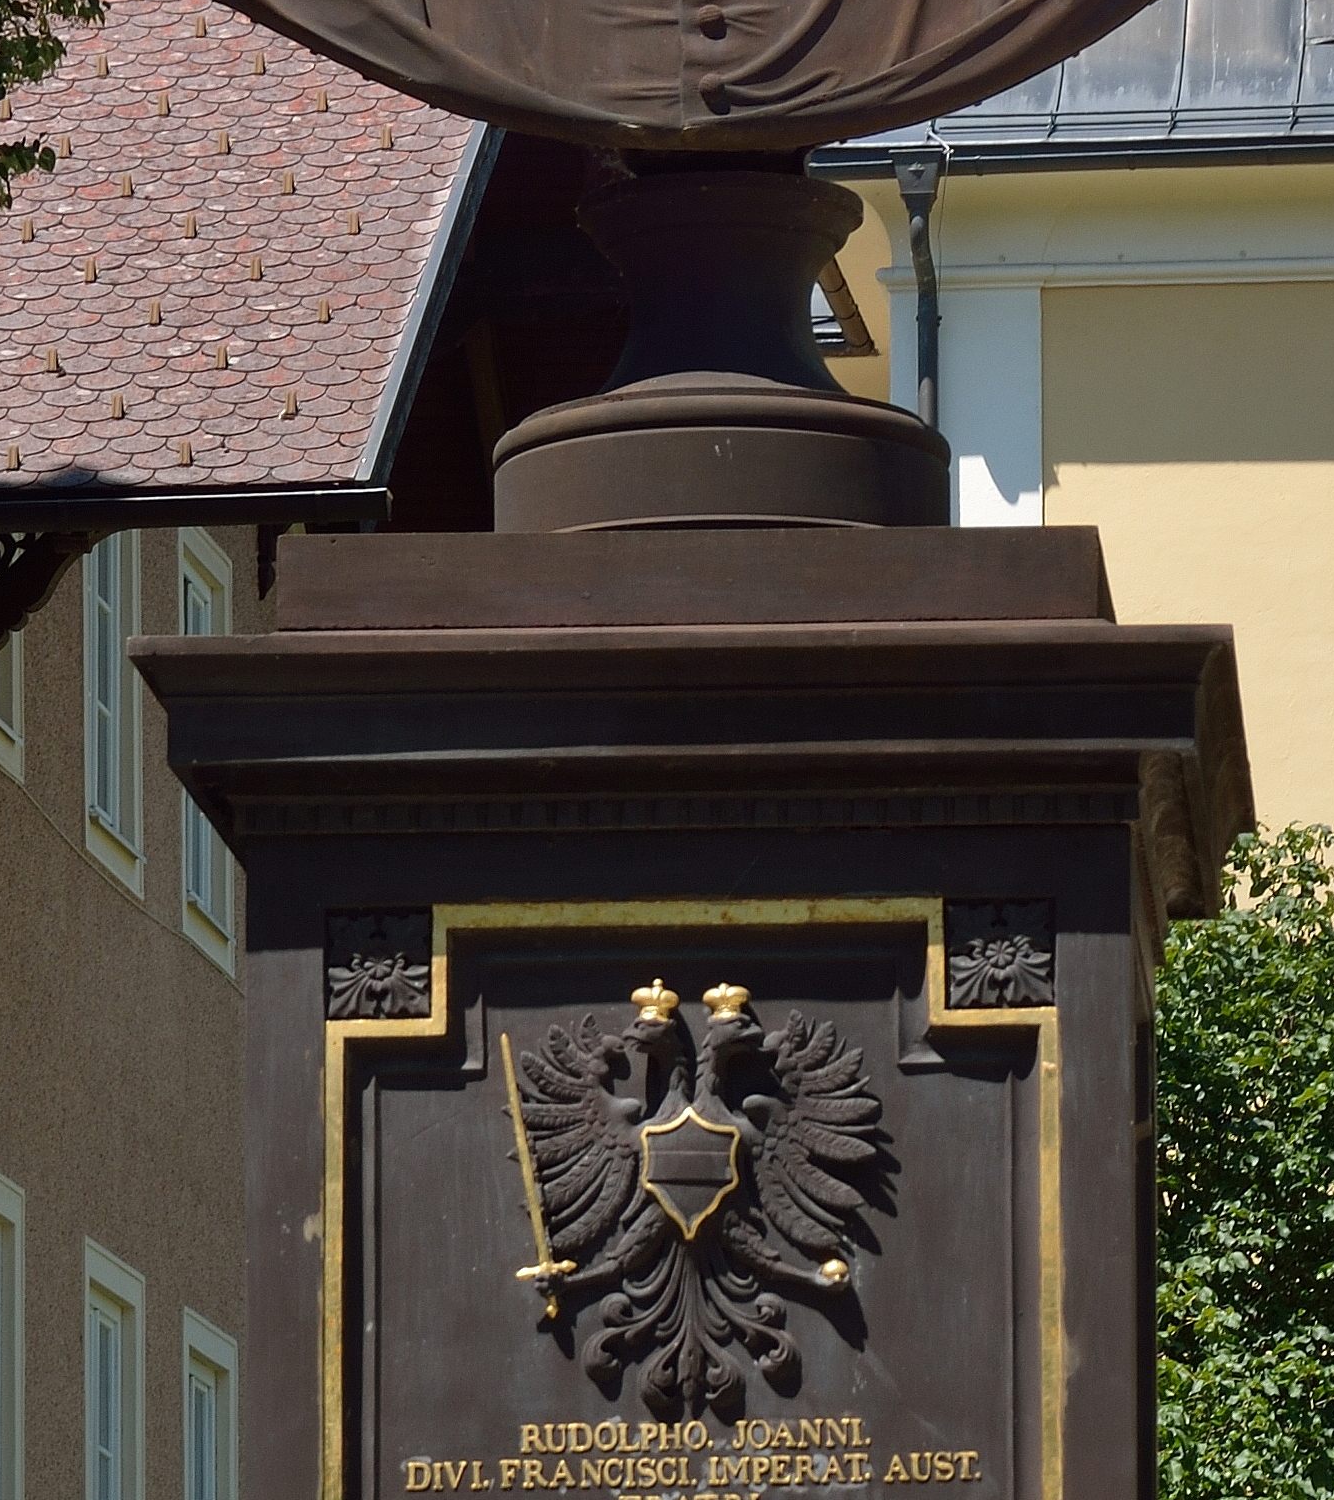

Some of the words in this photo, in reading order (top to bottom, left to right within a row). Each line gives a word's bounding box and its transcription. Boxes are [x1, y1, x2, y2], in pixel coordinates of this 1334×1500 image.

[520, 1419, 715, 1454] RUDOLPHO.
[732, 1416, 872, 1450] JOANNI.
[405, 1459, 490, 1492] DIVI.
[498, 1456, 698, 1490] FRANCISCI.
[708, 1452, 872, 1487] IMPERAT.
[883, 1449, 980, 1484] AUST.
